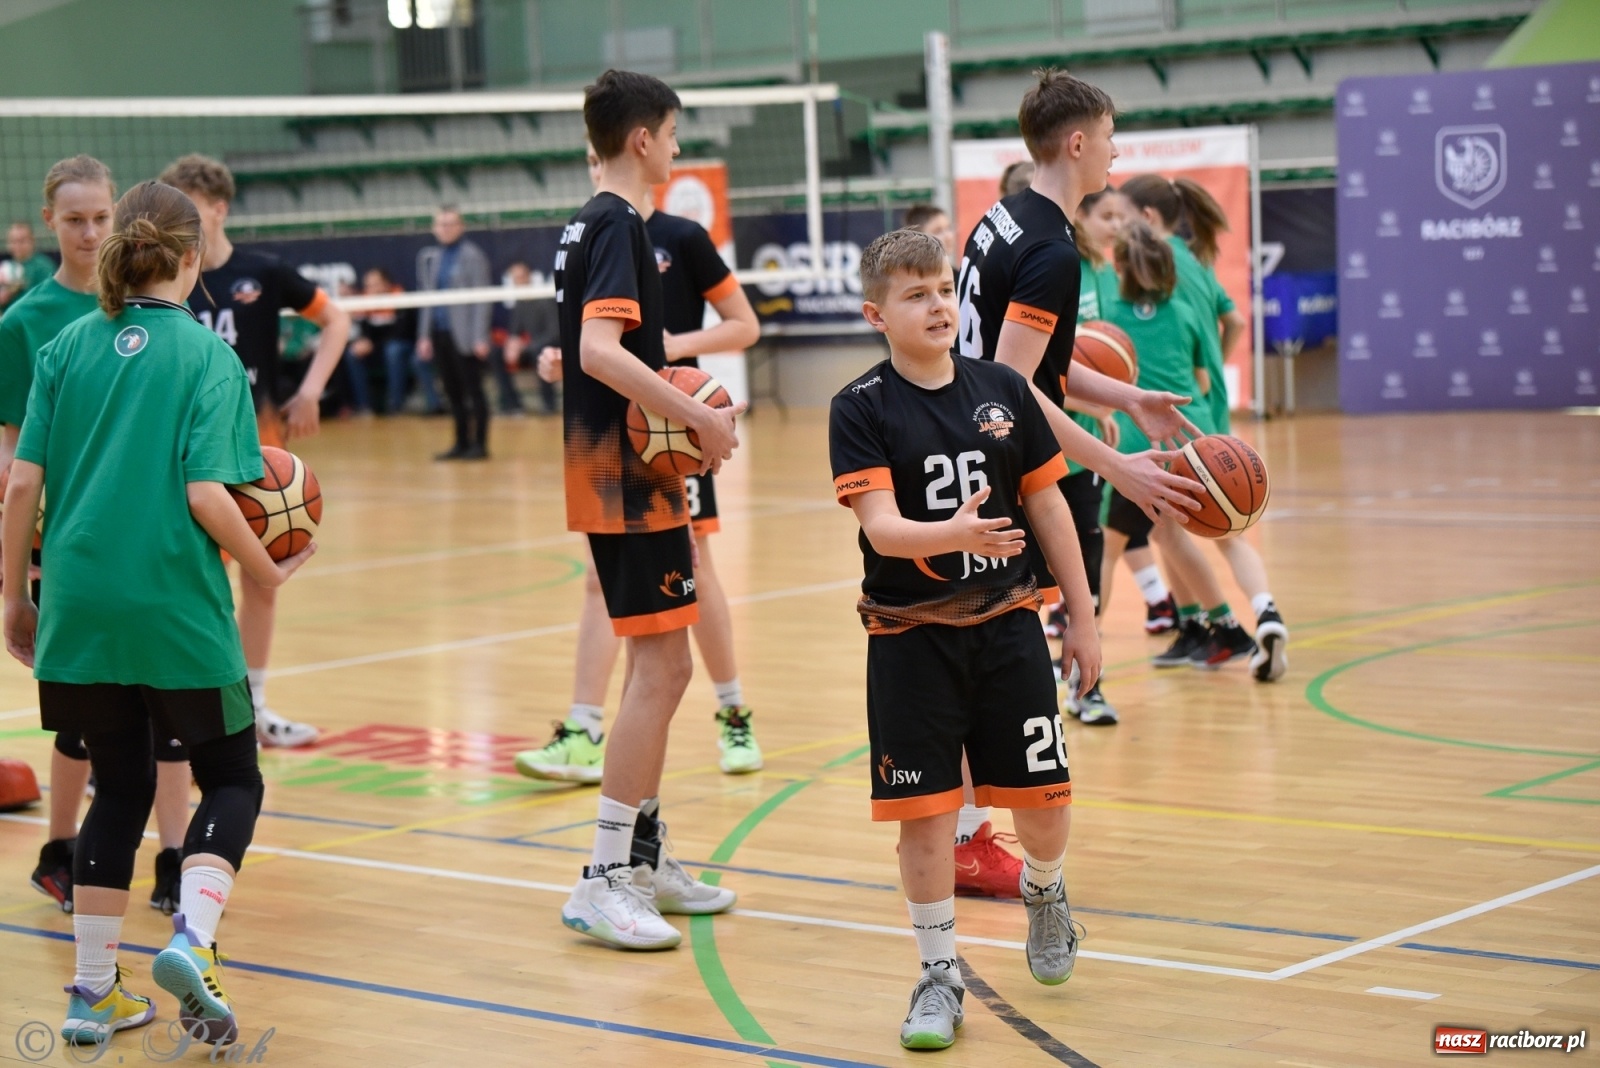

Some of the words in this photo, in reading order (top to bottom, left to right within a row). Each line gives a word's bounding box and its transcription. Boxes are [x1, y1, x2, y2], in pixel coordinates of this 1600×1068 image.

[595, 306, 633, 315] DAMONS
[1020, 310, 1054, 328] DAMONS
[1218, 450, 1237, 472] FIBA
[923, 450, 989, 511] 26
[890, 770, 922, 786] JSW
